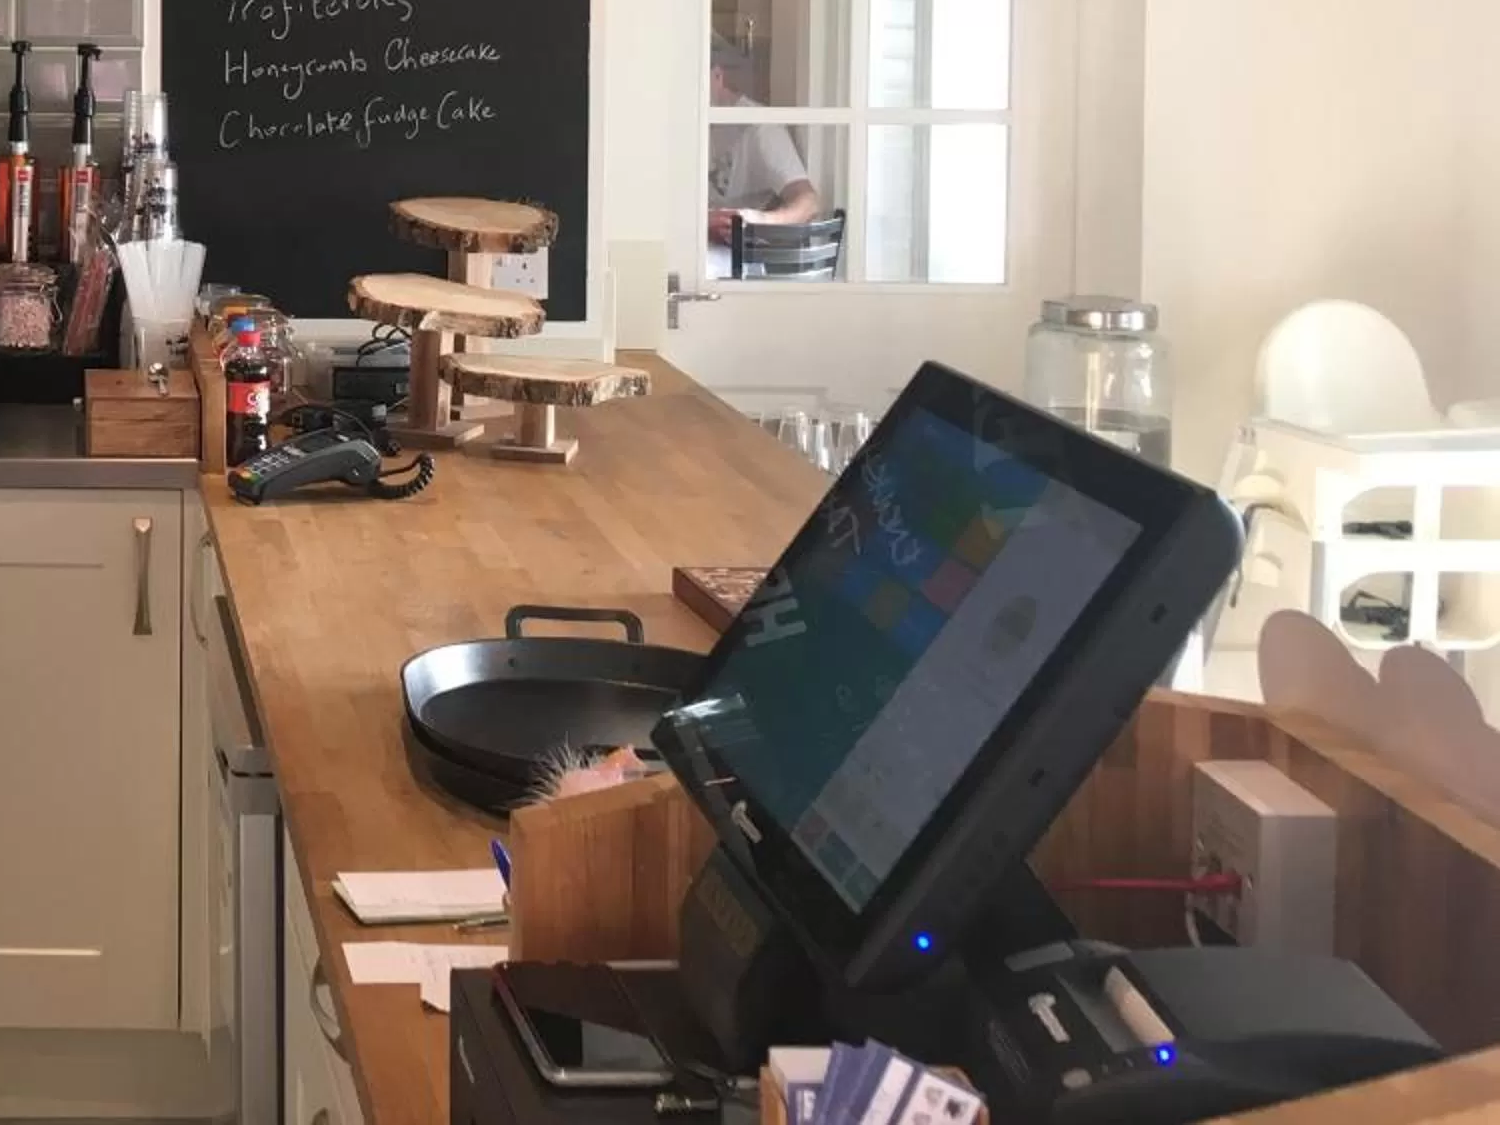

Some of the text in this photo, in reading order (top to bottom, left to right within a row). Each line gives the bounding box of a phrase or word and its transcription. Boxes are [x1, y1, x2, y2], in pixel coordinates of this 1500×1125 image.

[224, 37, 501, 100] Honeycomb Cheesecake
[219, 110, 353, 149] Chocolate
[436, 90, 496, 130] Cake
